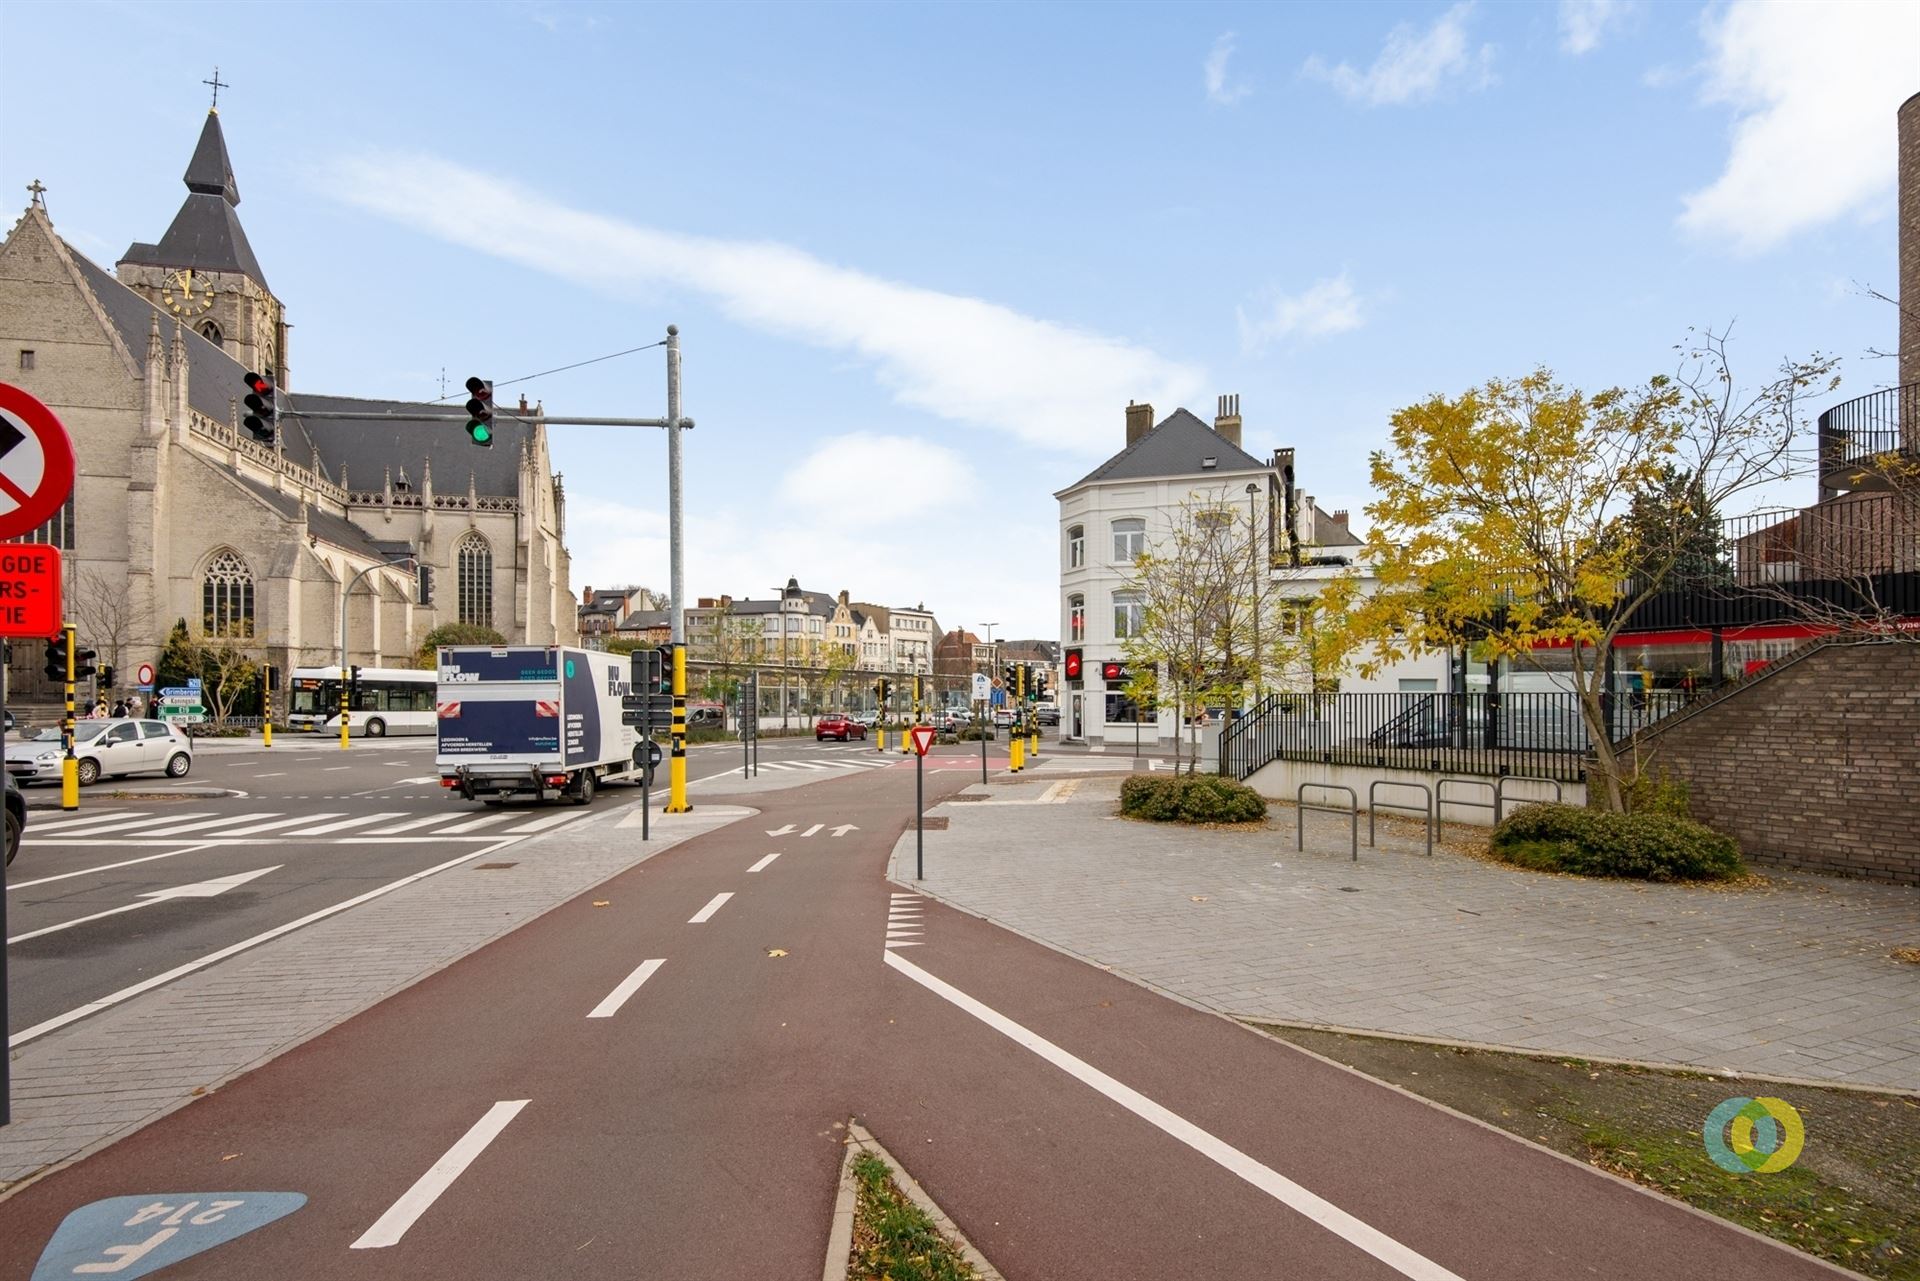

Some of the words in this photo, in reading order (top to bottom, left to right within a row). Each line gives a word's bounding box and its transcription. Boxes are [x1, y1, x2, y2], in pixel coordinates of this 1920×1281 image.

[2, 555, 46, 574] GDE
[444, 673, 479, 681] FLOW
[608, 665, 619, 681] NU
[166, 688, 201, 696] Grimbergen
[608, 682, 630, 697] FLOW
[123, 1200, 245, 1226] 214
[72, 1227, 180, 1274] F
